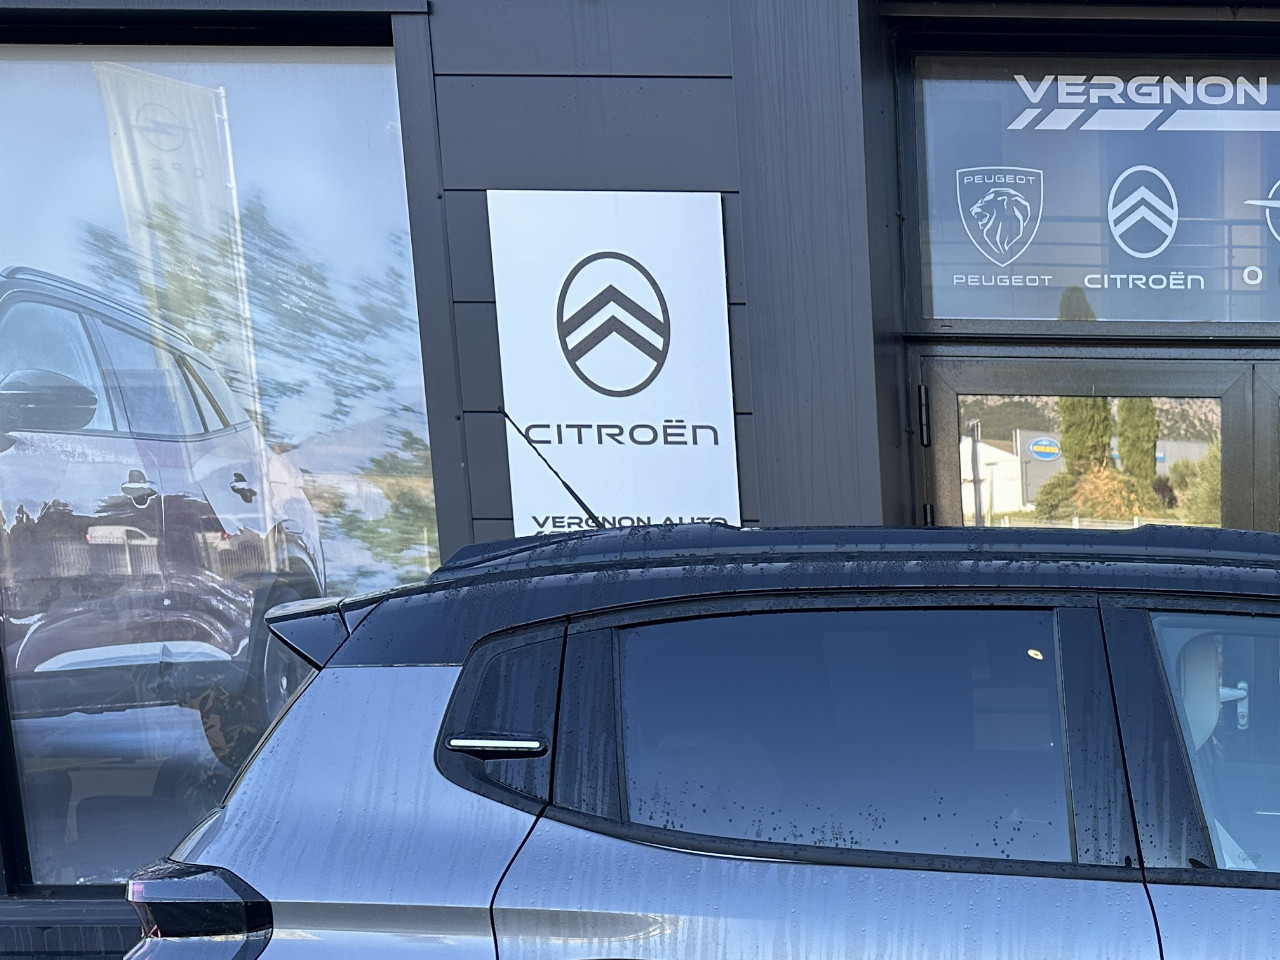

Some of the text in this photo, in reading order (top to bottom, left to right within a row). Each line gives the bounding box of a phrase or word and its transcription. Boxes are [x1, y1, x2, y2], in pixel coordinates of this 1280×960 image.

[1013, 75, 1268, 105] VERGNON
[964, 174, 1036, 185] PEUGEOT
[953, 274, 1053, 286] PEUGEOT
[1084, 271, 1205, 289] CITROËN
[524, 419, 719, 446] CITROËN
[531, 516, 650, 529] VERGNON
